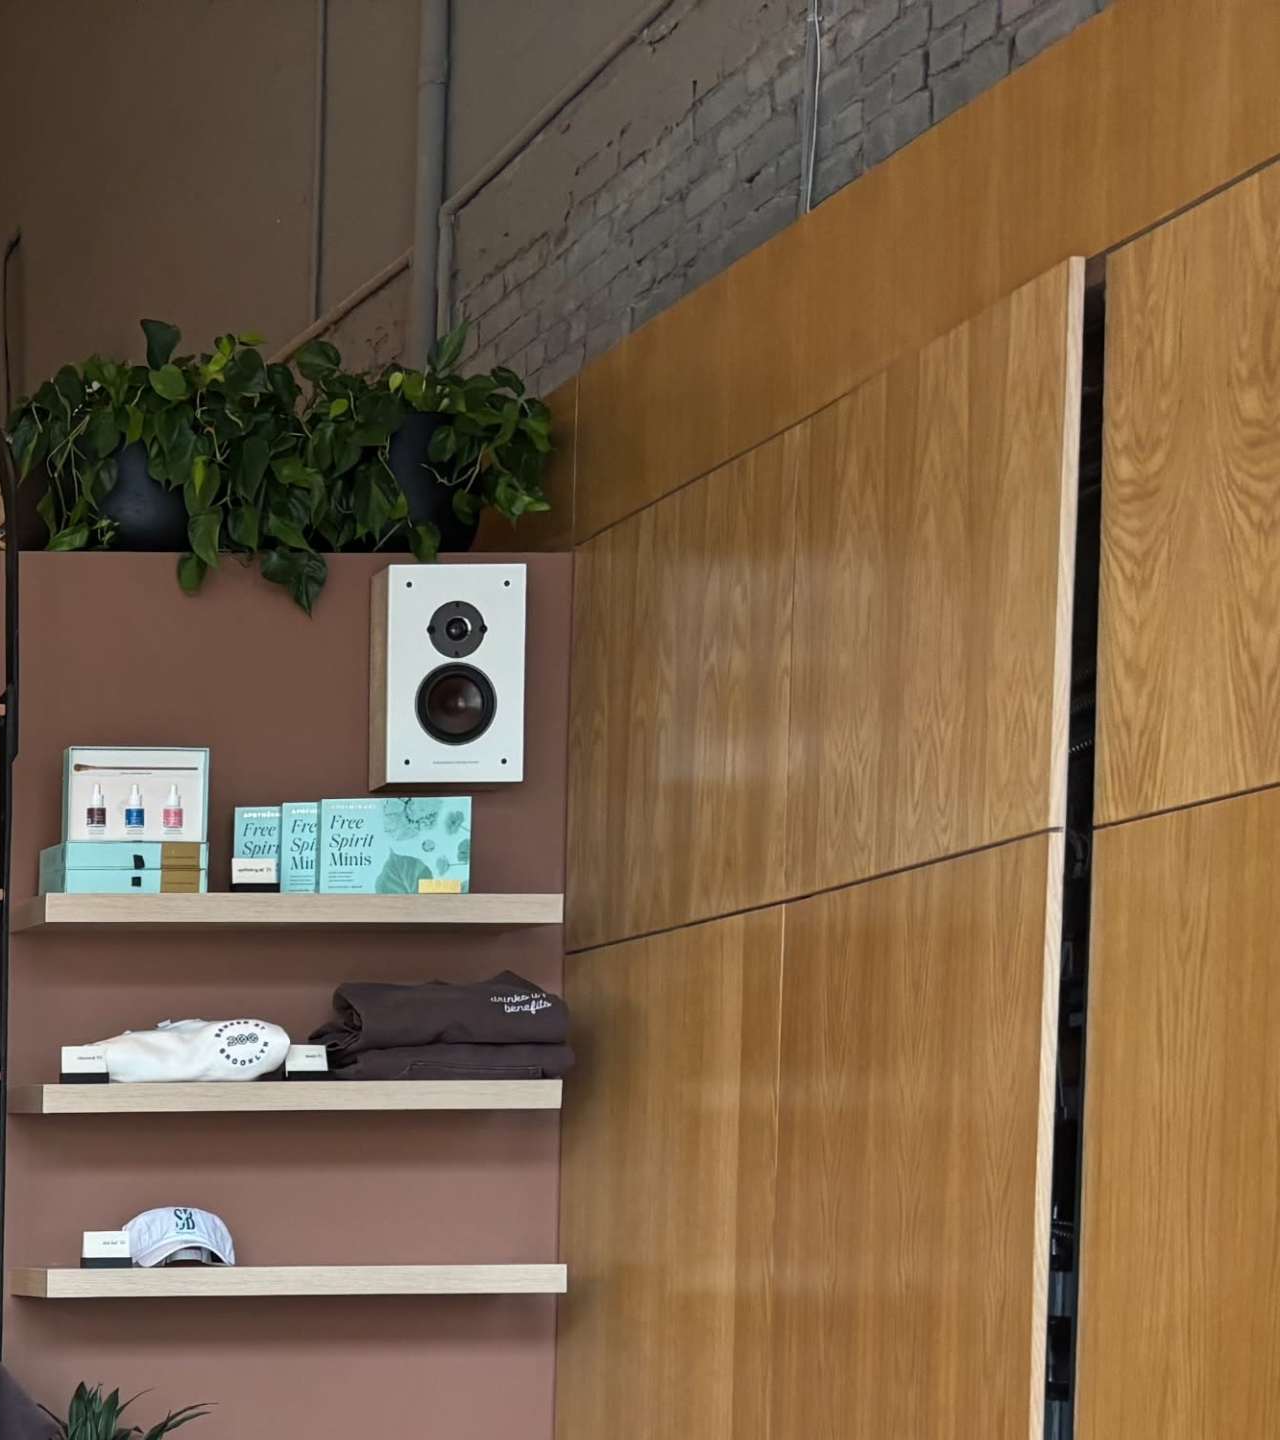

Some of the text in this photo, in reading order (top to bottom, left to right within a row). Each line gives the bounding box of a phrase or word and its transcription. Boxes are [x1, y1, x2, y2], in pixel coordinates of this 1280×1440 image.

[242, 822, 277, 837] Free
[330, 814, 365, 830] Free
[329, 833, 374, 851] Spirit
[330, 852, 373, 867] Minis
[504, 999, 552, 1015] benefits
